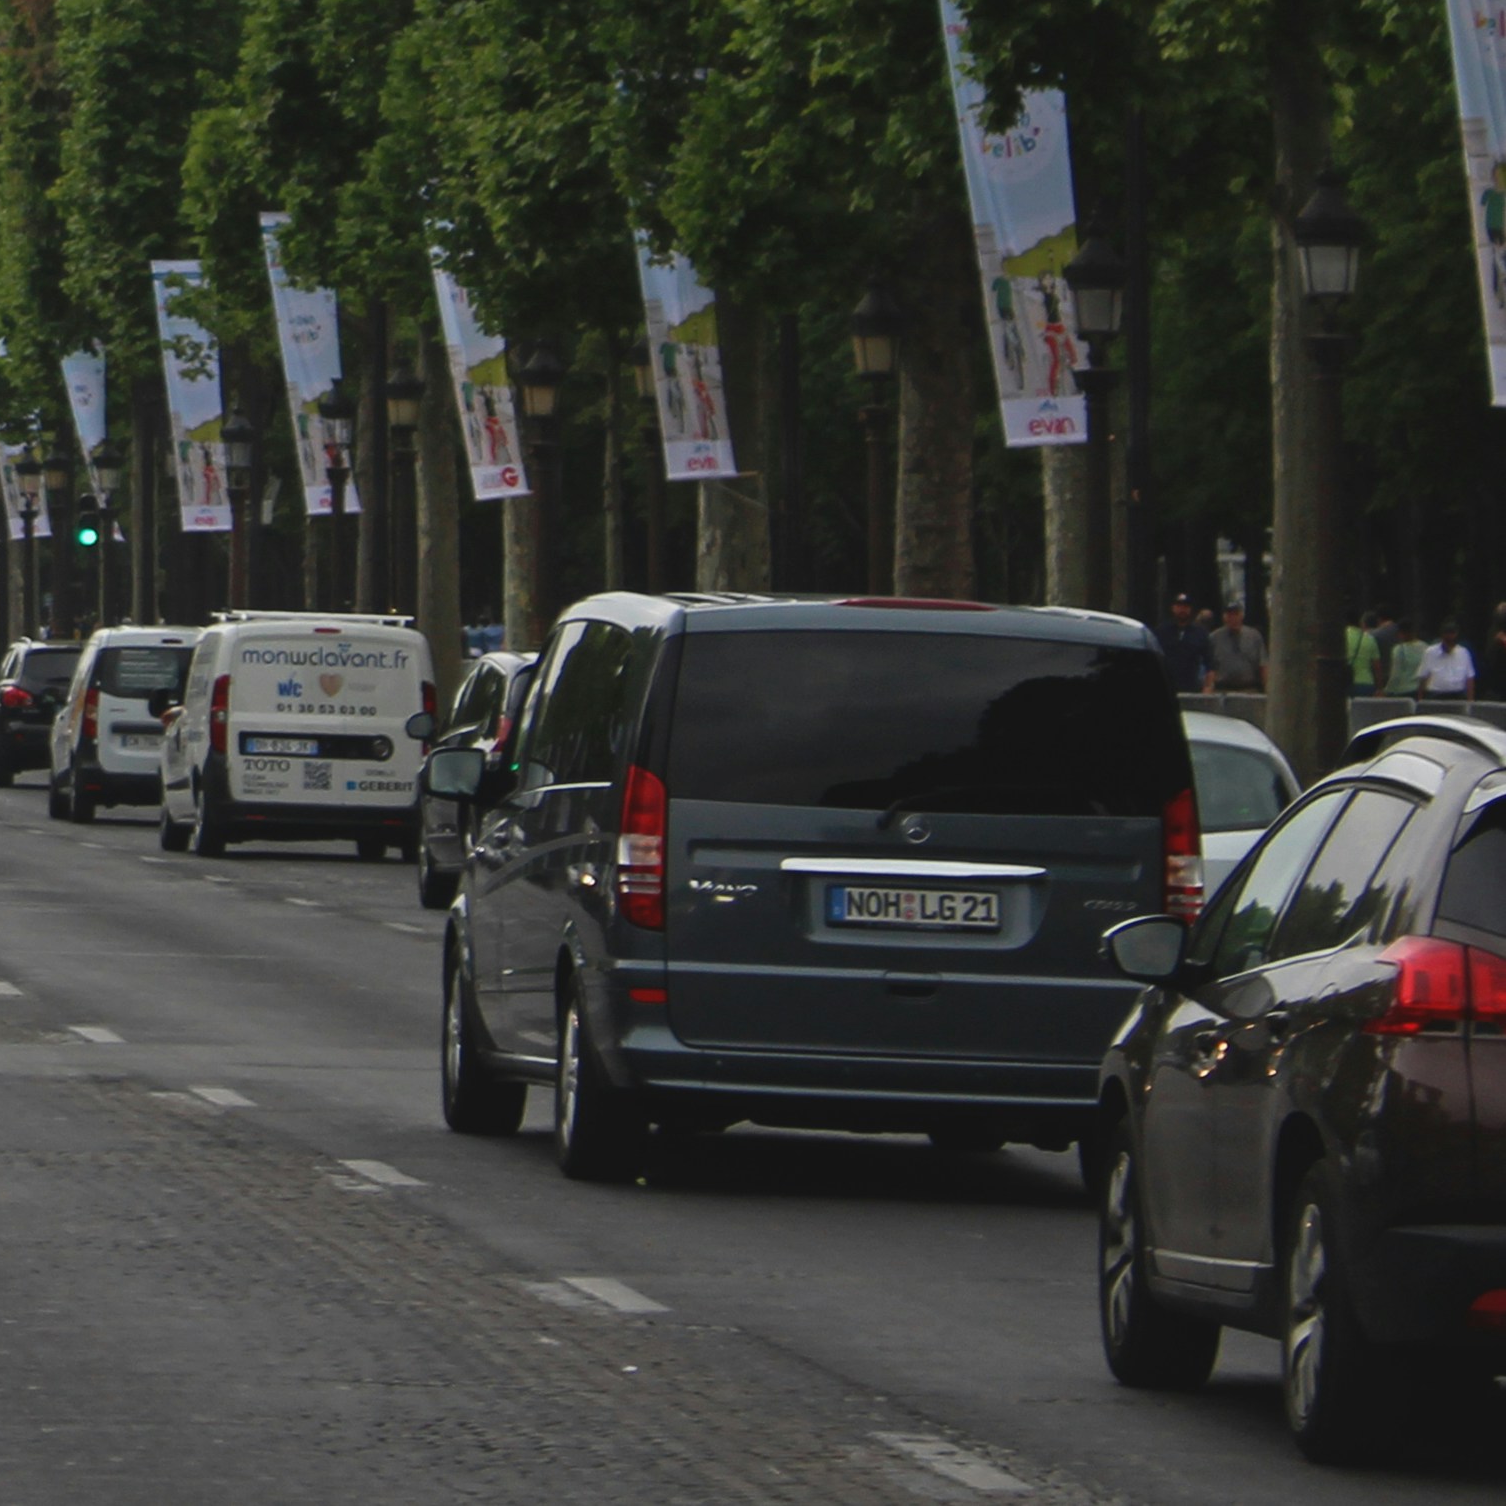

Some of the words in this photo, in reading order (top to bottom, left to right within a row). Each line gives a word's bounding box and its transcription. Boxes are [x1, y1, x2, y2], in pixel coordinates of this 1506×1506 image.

[243, 759, 291, 772] TOTO
[358, 780, 414, 792] GEBERIT
[847, 891, 901, 918] NOH
[921, 894, 956, 921] LG
[963, 896, 997, 922] 21
